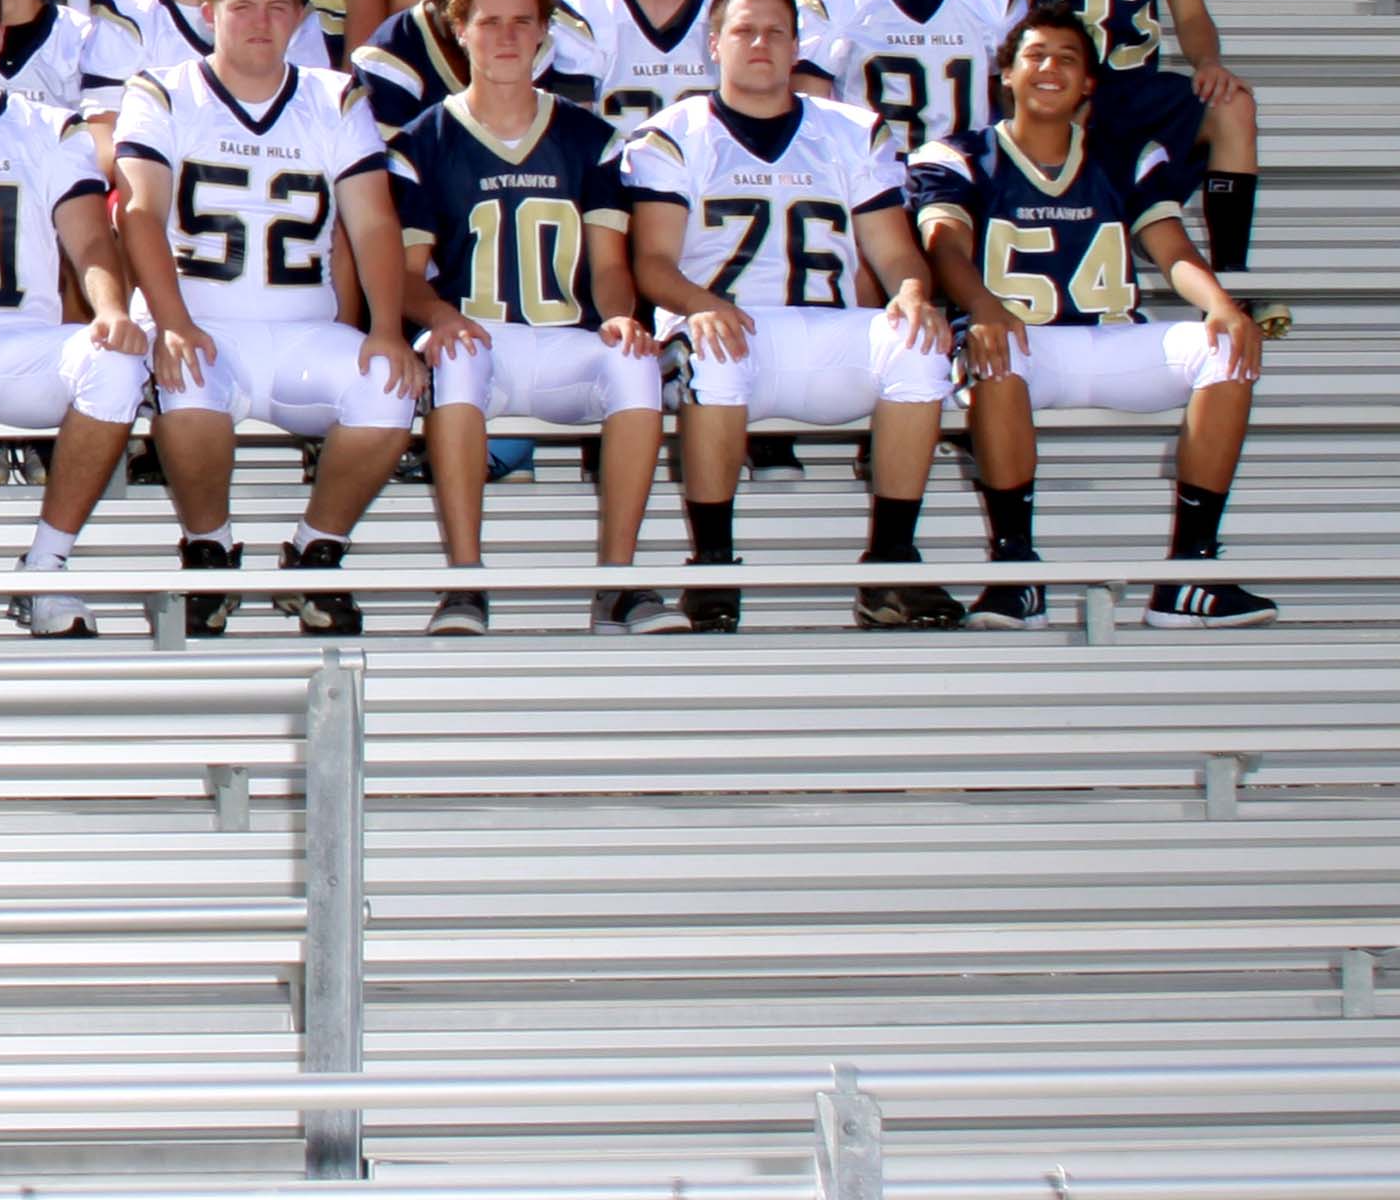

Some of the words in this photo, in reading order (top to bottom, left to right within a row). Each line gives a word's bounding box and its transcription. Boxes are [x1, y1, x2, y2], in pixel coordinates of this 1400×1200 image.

[887, 34, 925, 47] SALEM
[931, 34, 964, 47] HILLS
[632, 64, 668, 77] SALEM
[674, 64, 705, 76] HILLS
[220, 141, 260, 157] SALEM
[267, 145, 300, 159] HILLS
[480, 174, 557, 189] SKYHAWKS
[175, 158, 332, 288] 52
[1016, 207, 1093, 221] SKYHAWKS
[704, 195, 848, 308] 76
[461, 196, 581, 327] 10
[984, 217, 1136, 326] 54
